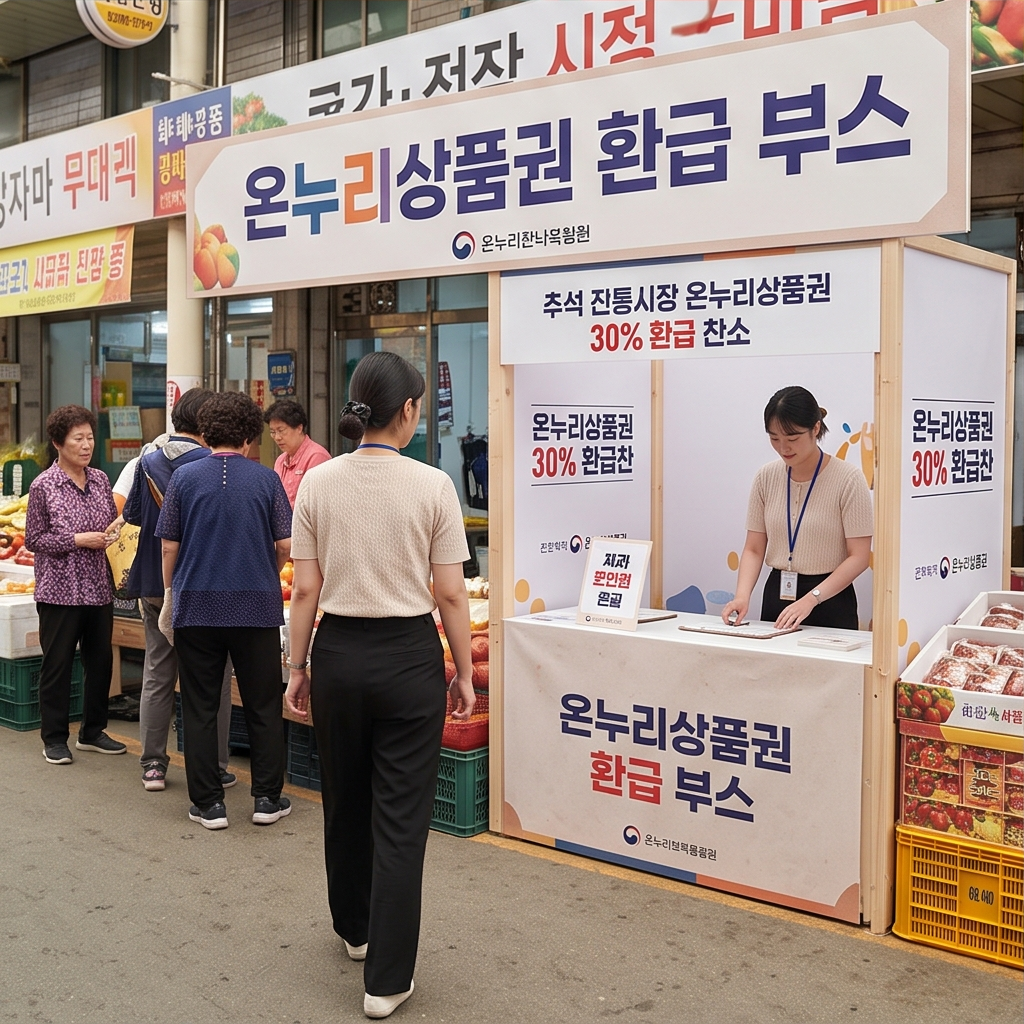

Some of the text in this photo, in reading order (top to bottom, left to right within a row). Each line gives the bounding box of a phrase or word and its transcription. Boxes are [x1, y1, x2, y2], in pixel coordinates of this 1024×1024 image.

[243, 116, 574, 242] 온누리상품권
[597, 96, 733, 197] 환급
[758, 73, 912, 177] 부스
[542, 290, 585, 319] 추석
[685, 271, 832, 312] 온누리상품권
[589, 317, 752, 353] 30% 환급 찬소
[532, 412, 634, 442] 온누리상품권
[912, 409, 994, 443] 온누리상품권
[531, 445, 635, 478] 30% 환급찬
[911, 449, 994, 488] 30% 환급찬
[558, 692, 792, 774] 온누리상품권
[589, 749, 756, 824] 환급 부스
